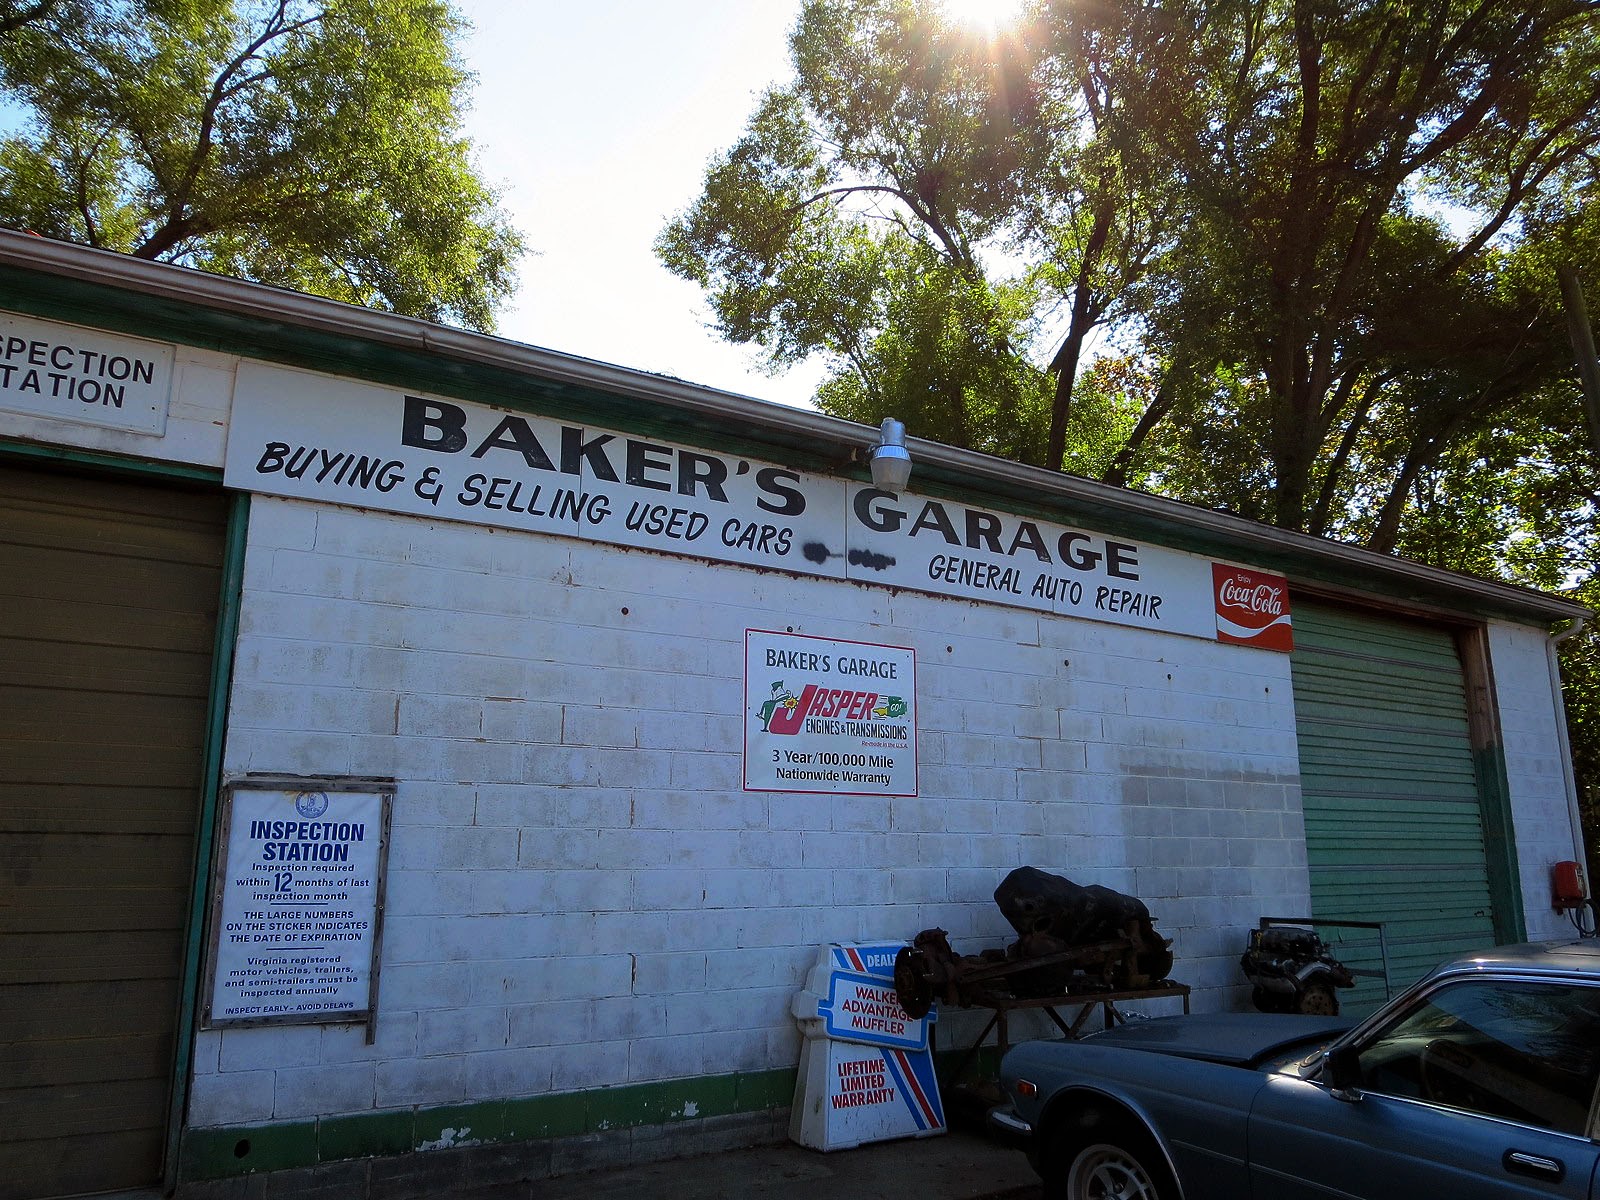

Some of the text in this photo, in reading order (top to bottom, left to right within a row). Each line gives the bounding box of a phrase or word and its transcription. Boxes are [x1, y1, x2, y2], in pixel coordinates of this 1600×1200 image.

[0, 335, 154, 384] PECTION
[0, 364, 125, 408] TATION
[401, 395, 1140, 581] BAKER'S GARAGE
[256, 442, 793, 556] BUYING & SELLING USED CARS
[928, 554, 1163, 620] GENERAL AUTO REPAIR
[1237, 574, 1251, 584] Enjoy
[1220, 578, 1282, 615] Coca-Cola
[766, 649, 898, 680] BAKER'S GARAGE
[768, 684, 879, 735] JASPER
[806, 719, 840, 736] ENGINES
[846, 721, 907, 740] TRANSMISSIONS
[772, 750, 894, 768] 3 Year/100,000 Mile
[776, 768, 891, 786] Nationwide Warranty
[250, 821, 364, 841] INSPECTION
[263, 842, 348, 862] STATION
[252, 863, 355, 873] Inspection required
[236, 872, 369, 892] within 12 months of last
[253, 892, 348, 901] inspection month
[244, 910, 354, 919] THE LARGE NUMBERS
[226, 922, 368, 931] ON THE STICKER INDICATES
[230, 933, 362, 942] THE DATE OF EXPIRATION
[247, 956, 341, 966] Virginia registered
[229, 966, 354, 976] motor vehicles, trailers,
[225, 975, 358, 987] and semi-trailers must be
[240, 986, 339, 998] inspected annually
[225, 1006, 260, 1014] INSPECT
[263, 1005, 289, 1013] EARLY
[296, 1003, 322, 1011] AVOID
[323, 1002, 354, 1010] DELAYS
[852, 1015, 905, 1035] MUFFLER
[837, 1059, 886, 1077] LIFETIME
[840, 1074, 885, 1092] LIMITED
[831, 1088, 895, 1109] WARRANTY
